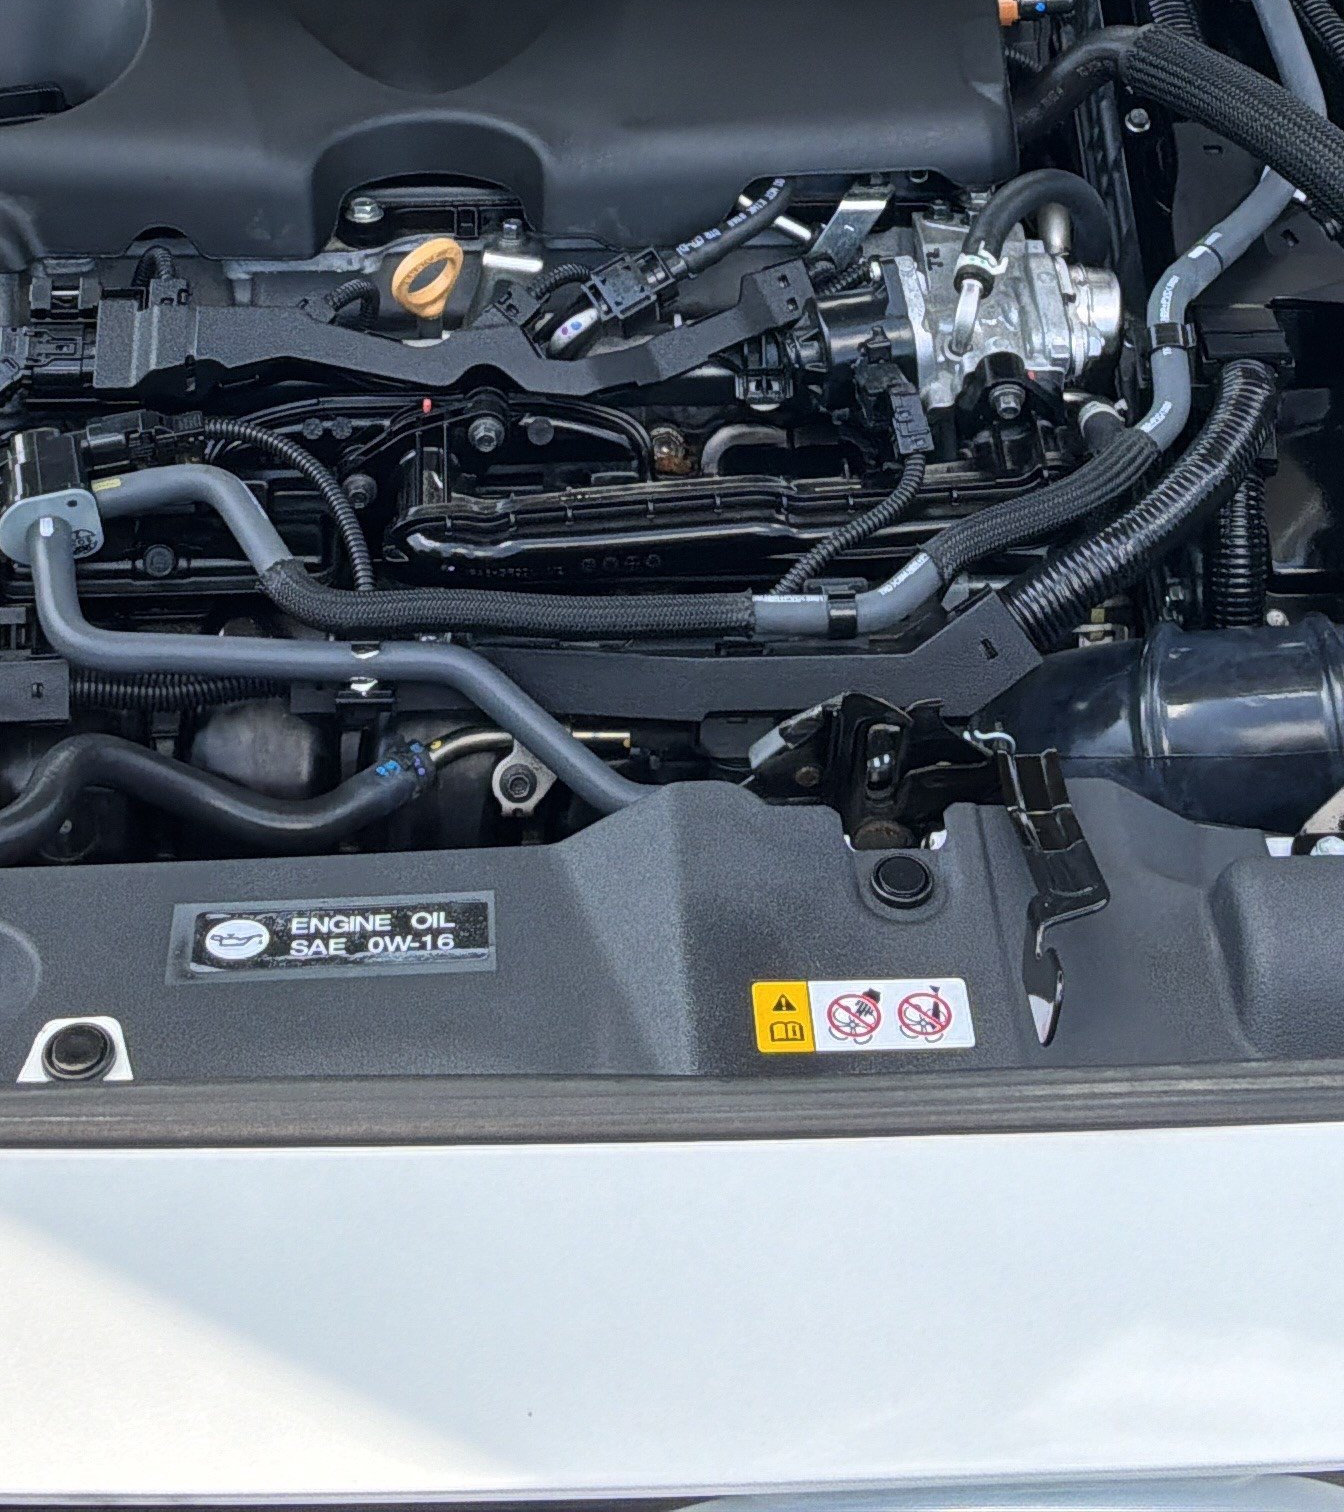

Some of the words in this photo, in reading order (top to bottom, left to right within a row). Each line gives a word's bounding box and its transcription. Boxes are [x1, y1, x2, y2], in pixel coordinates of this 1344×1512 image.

[291, 913, 392, 935] ENGINE
[410, 911, 456, 930] OIL
[289, 937, 348, 956] SAE
[367, 933, 455, 954] 0W-16
